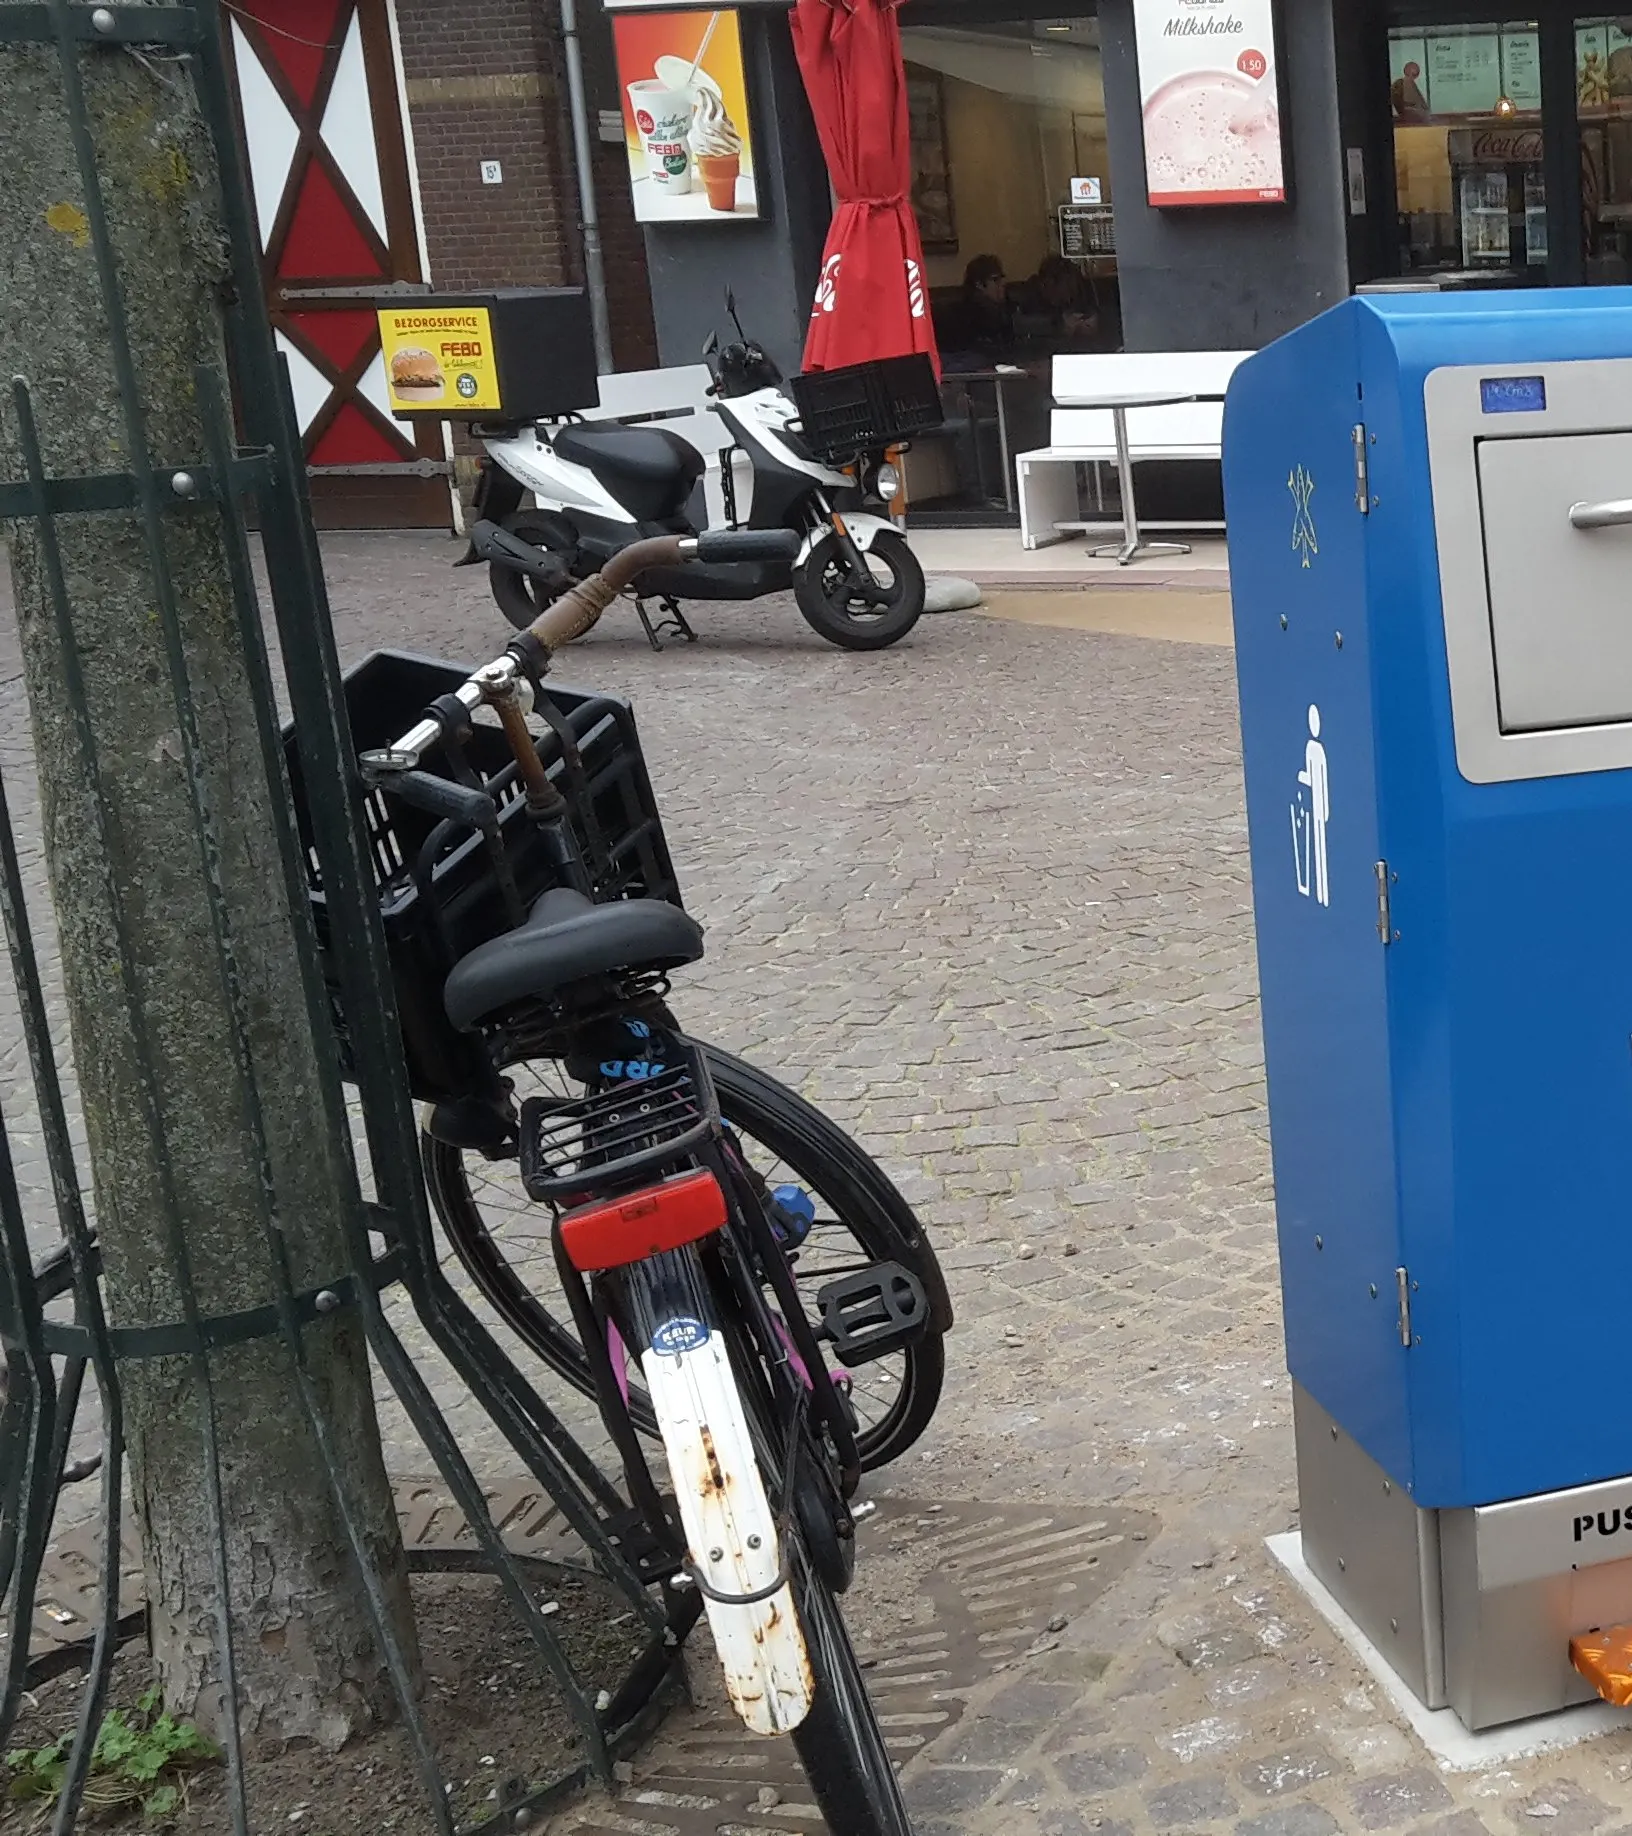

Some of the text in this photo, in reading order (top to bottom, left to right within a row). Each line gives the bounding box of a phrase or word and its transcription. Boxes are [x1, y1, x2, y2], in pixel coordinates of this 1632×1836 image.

[1163, 14, 1244, 36] Milkshake
[1241, 59, 1262, 71] 1.50
[648, 143, 682, 155] FEBO
[394, 316, 478, 329] BEZORGSERVICE
[440, 341, 483, 357] FEBO
